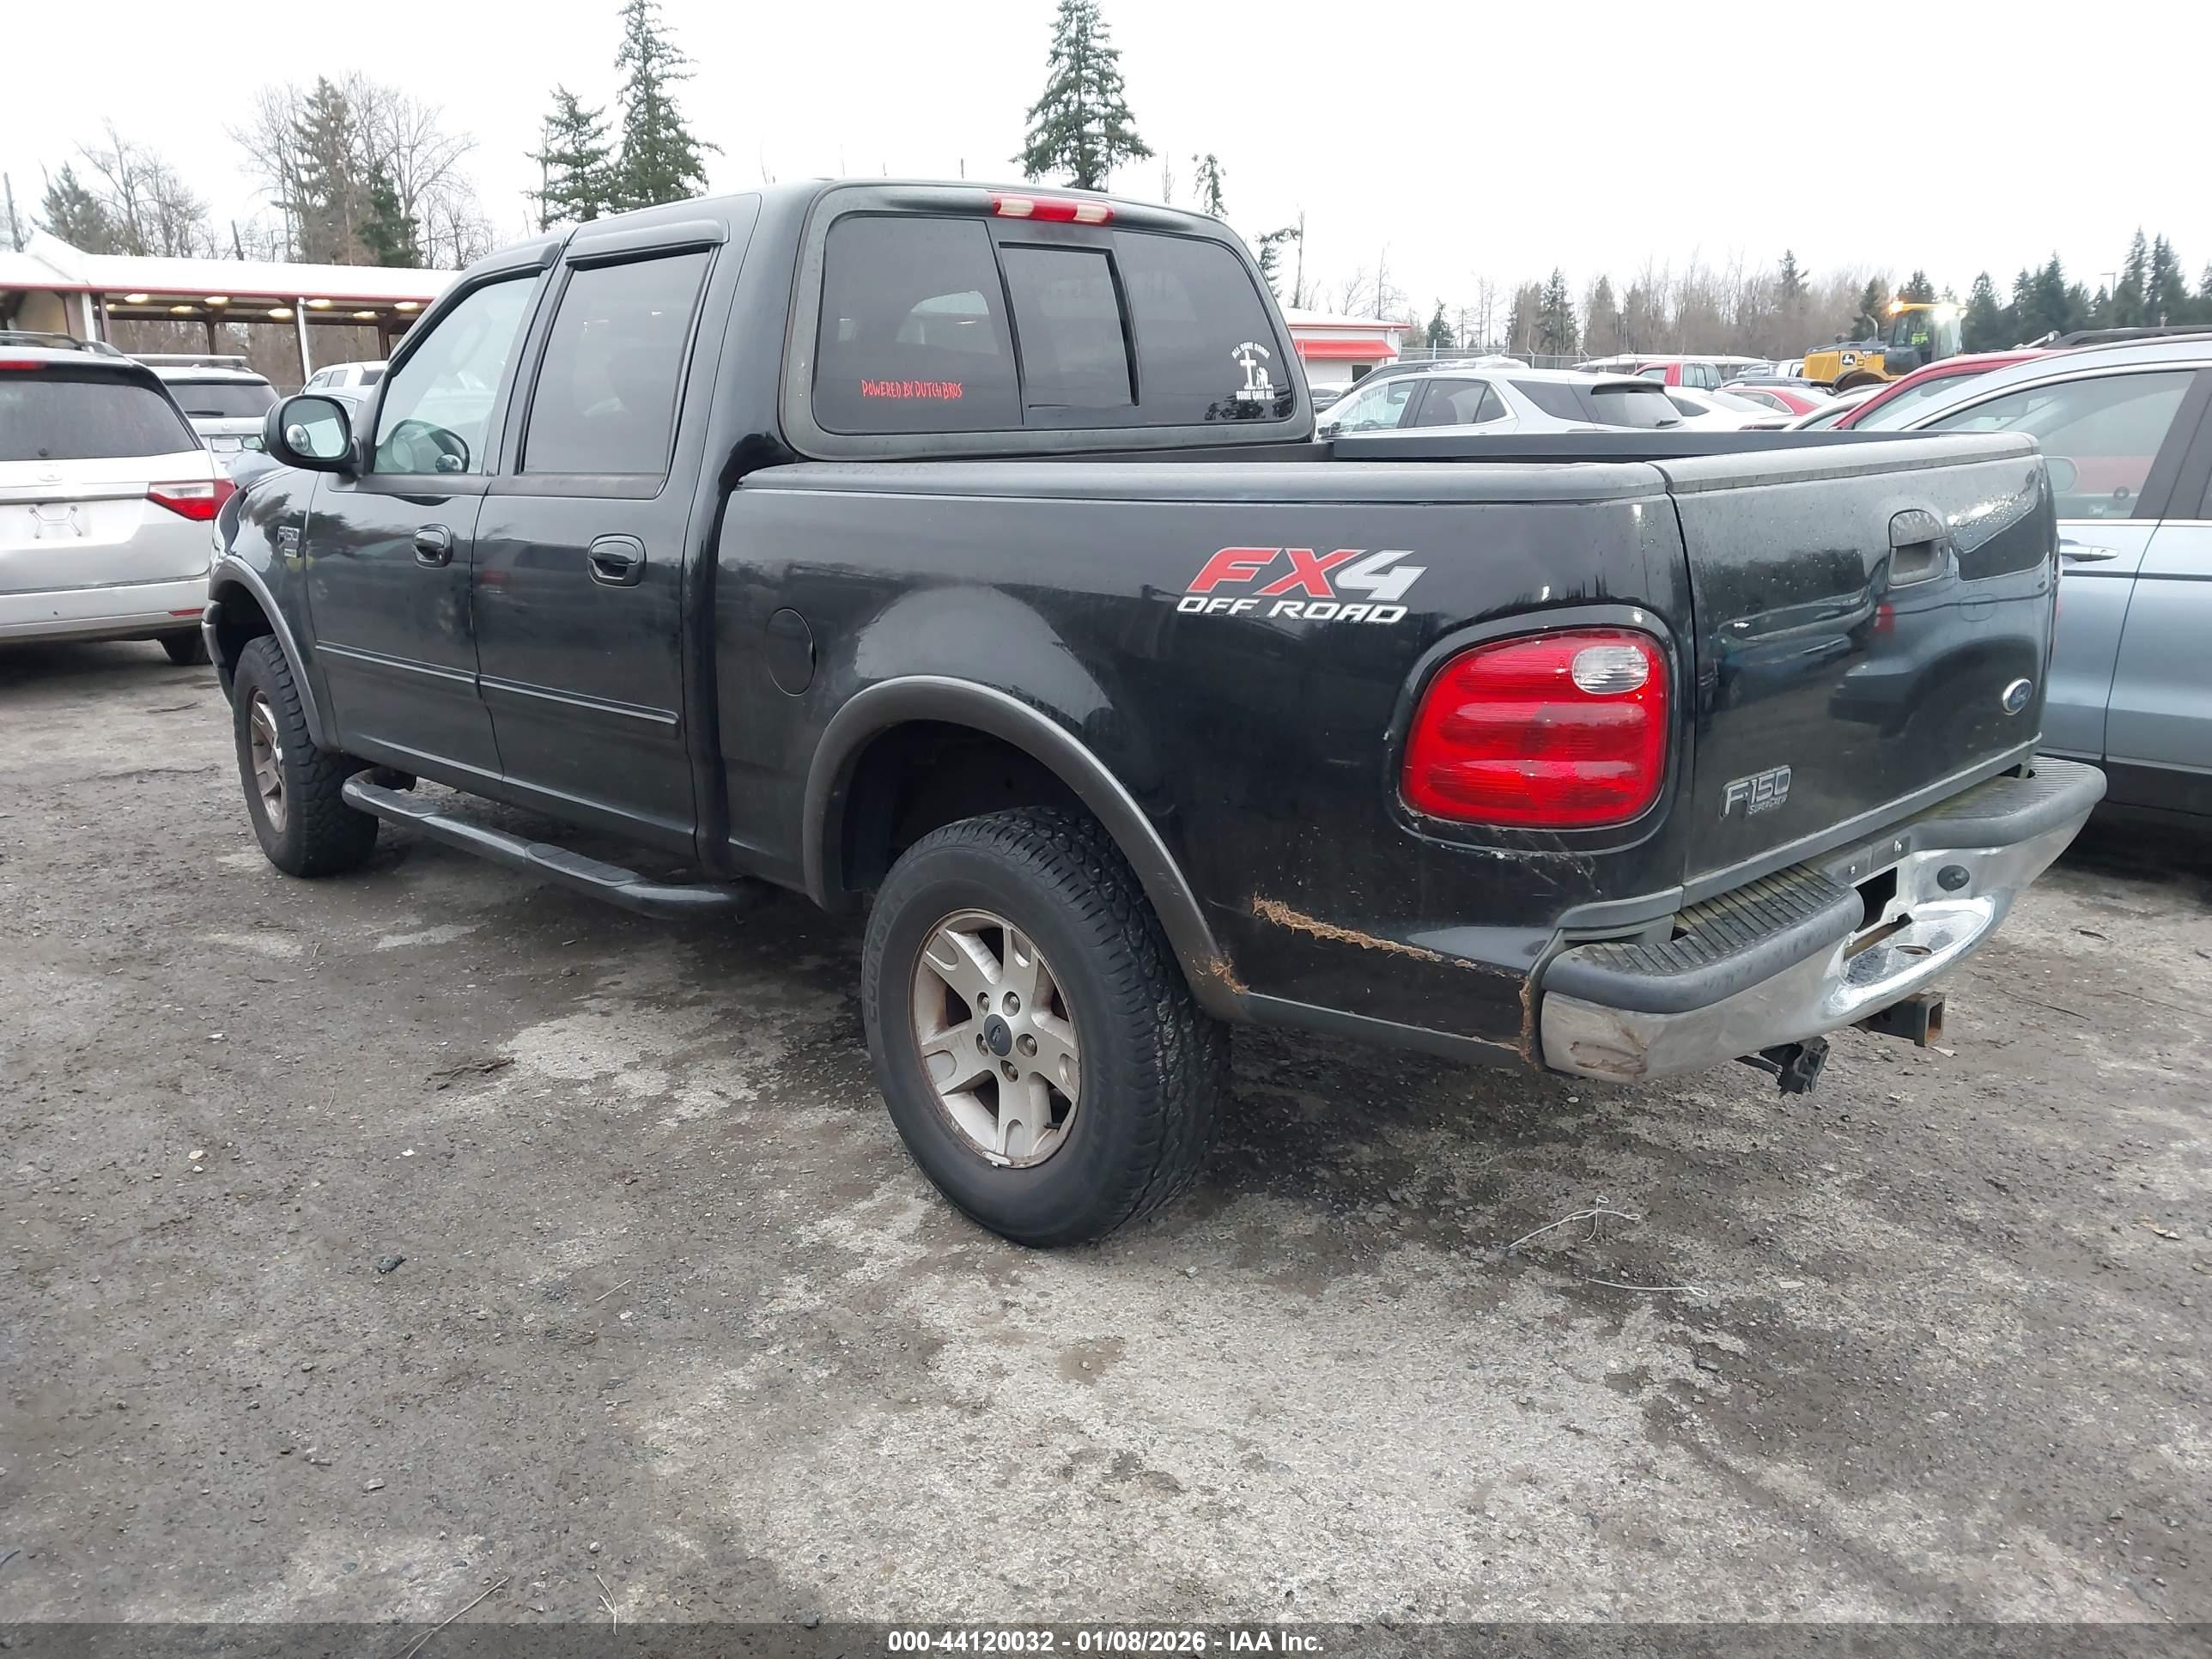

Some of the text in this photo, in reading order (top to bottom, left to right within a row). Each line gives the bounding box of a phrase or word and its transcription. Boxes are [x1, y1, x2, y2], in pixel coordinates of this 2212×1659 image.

[860, 378, 963, 399] POWERED BY DUTCH BROS
[1237, 390, 1252, 400] SOME
[1252, 390, 1266, 400] GAVE
[1185, 546, 1428, 601] FX4
[1176, 597, 1409, 624] OFF ROAD
